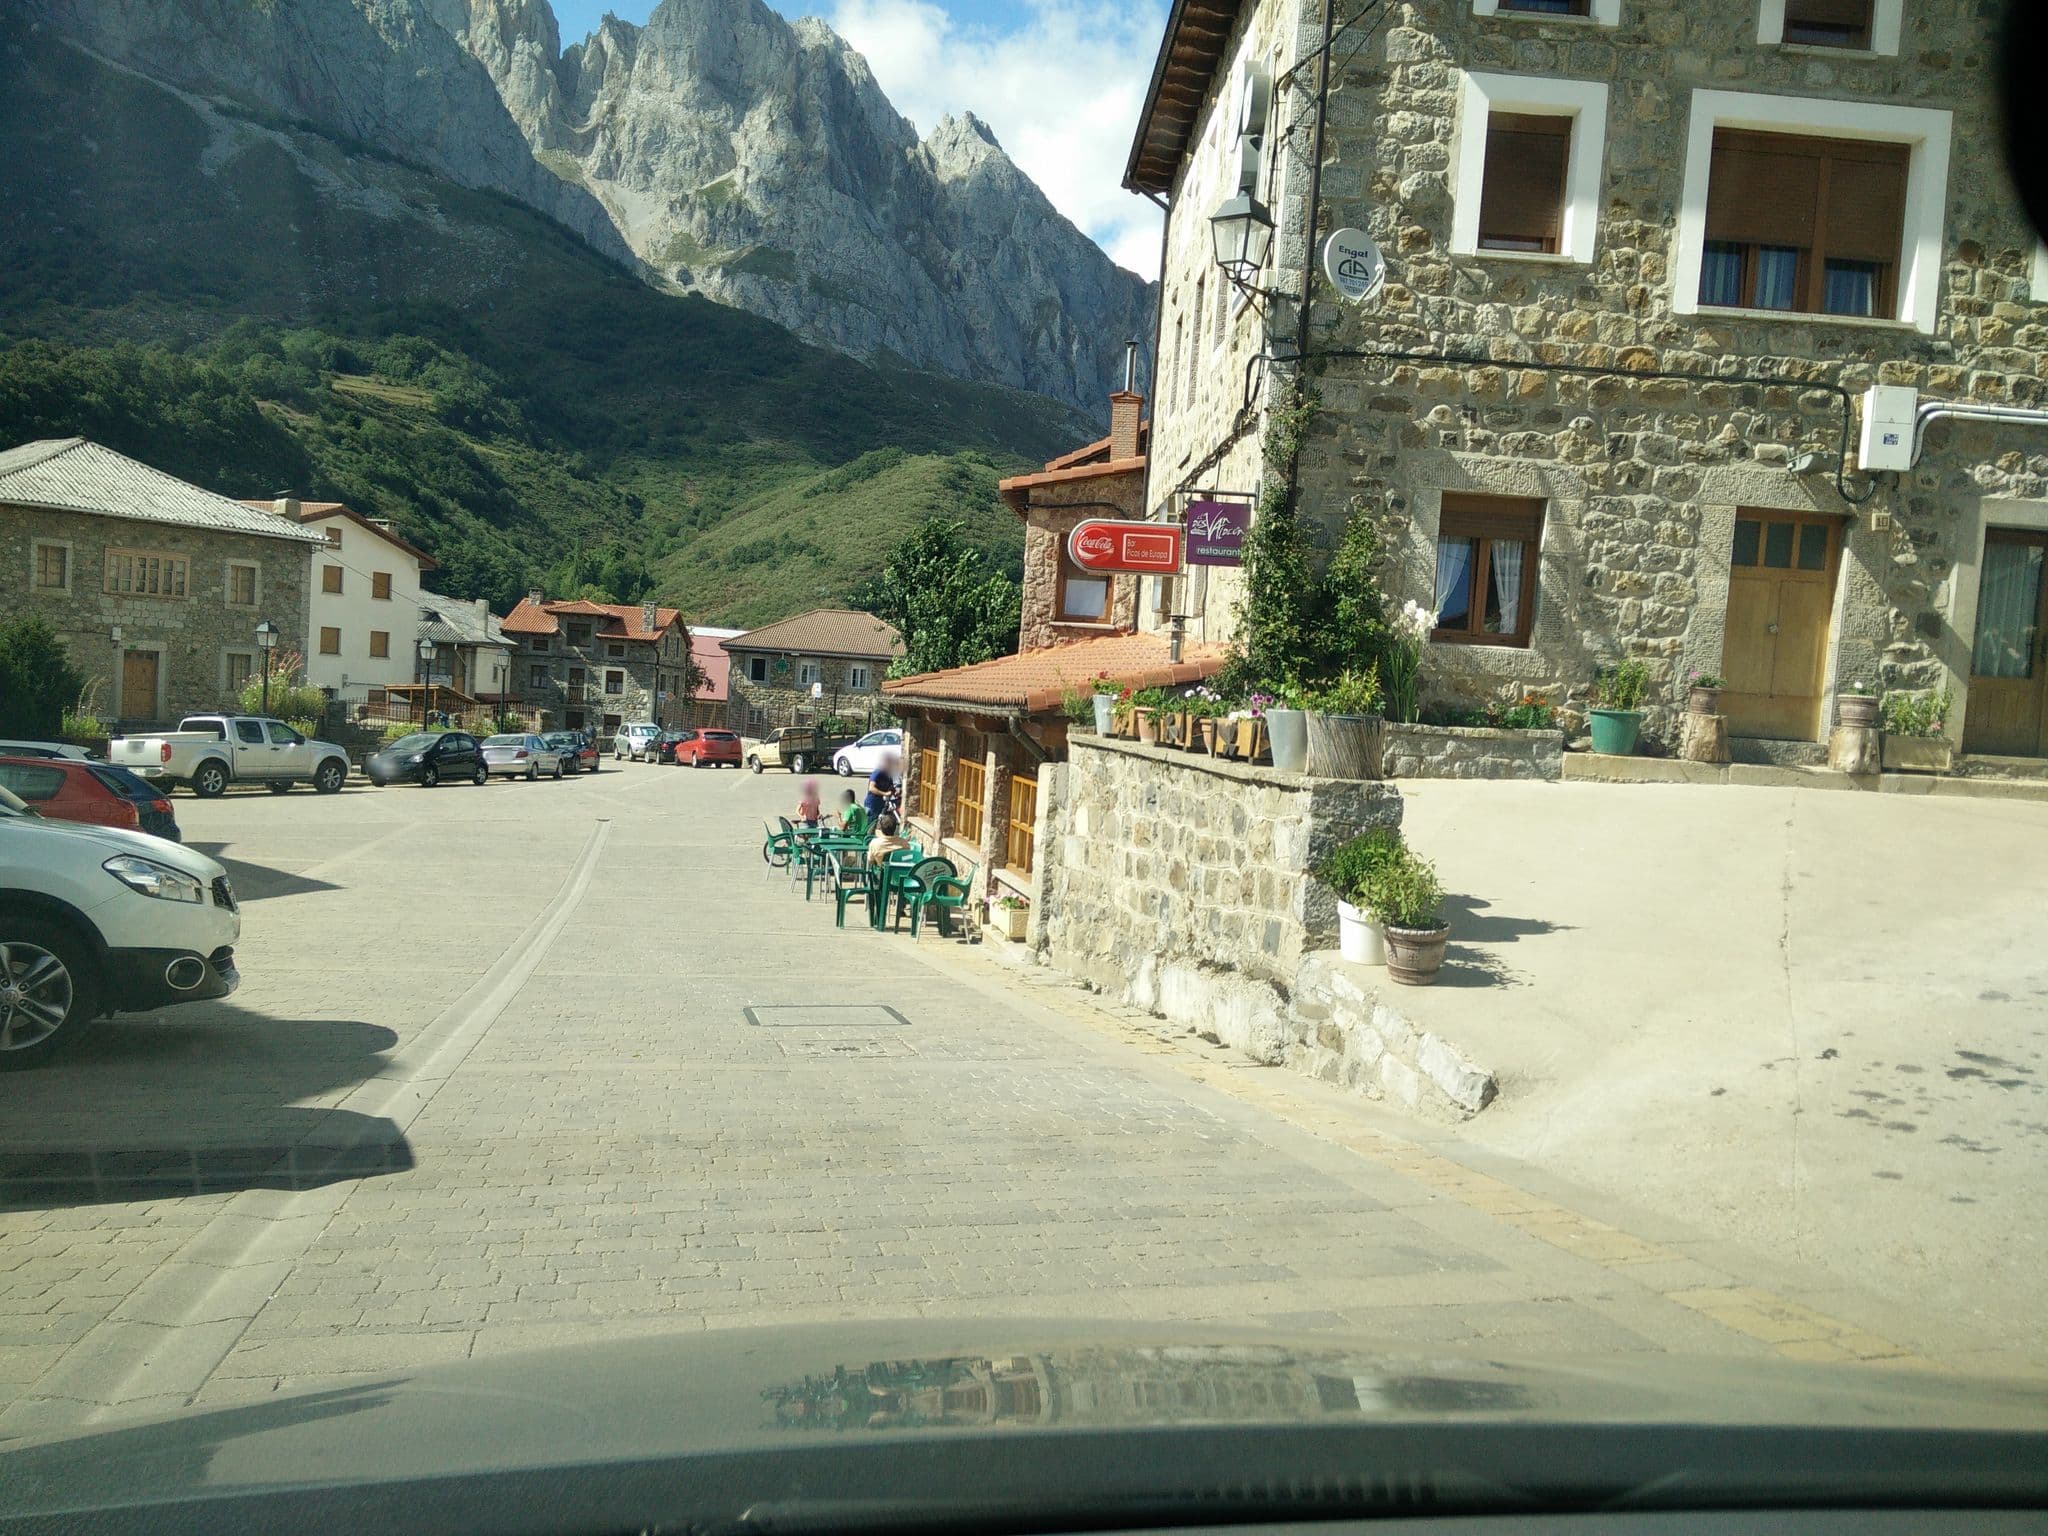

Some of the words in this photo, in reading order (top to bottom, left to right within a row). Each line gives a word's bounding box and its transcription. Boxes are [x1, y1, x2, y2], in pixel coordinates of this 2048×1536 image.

[1127, 539, 1136, 547] Bar
[1127, 549, 1140, 558] Picos
[1141, 550, 1149, 558] de
[1149, 550, 1168, 559] Europa
